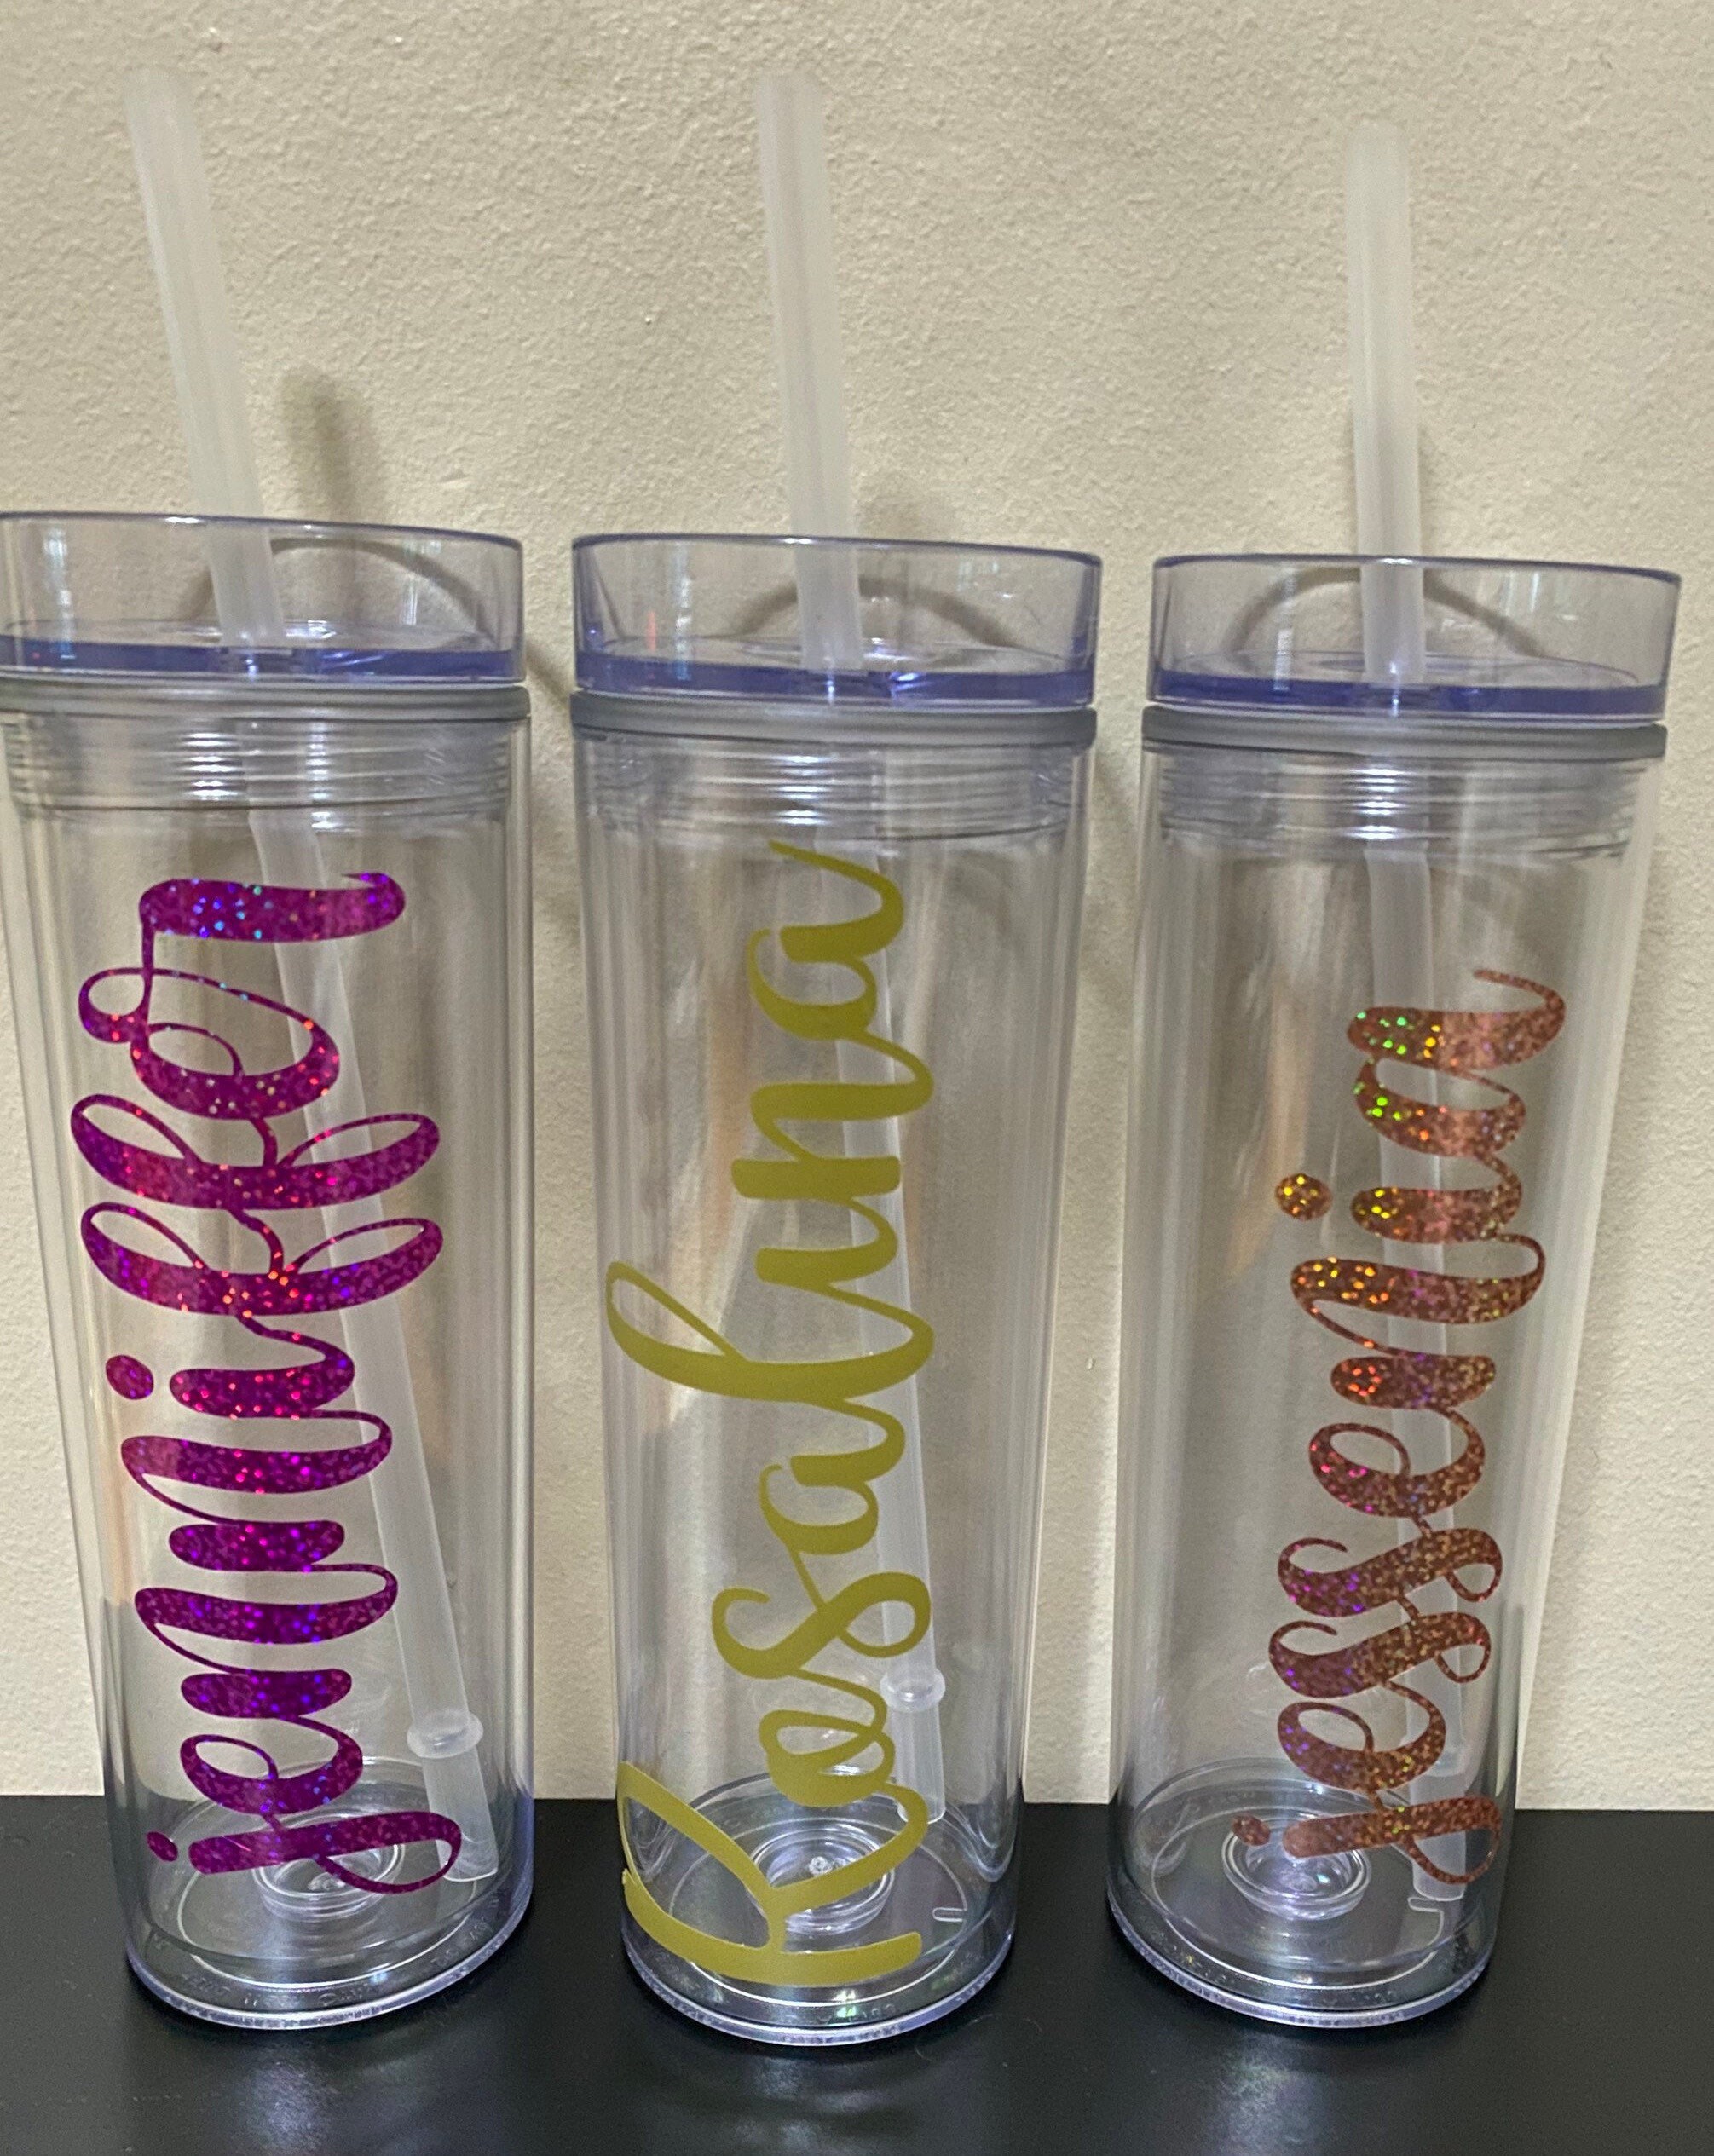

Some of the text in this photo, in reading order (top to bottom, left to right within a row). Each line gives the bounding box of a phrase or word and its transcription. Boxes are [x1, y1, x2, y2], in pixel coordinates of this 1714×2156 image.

[71, 871, 462, 1894] jenniffer
[607, 839, 934, 1984] Rosalina
[1232, 966, 1566, 1884] jessenia
